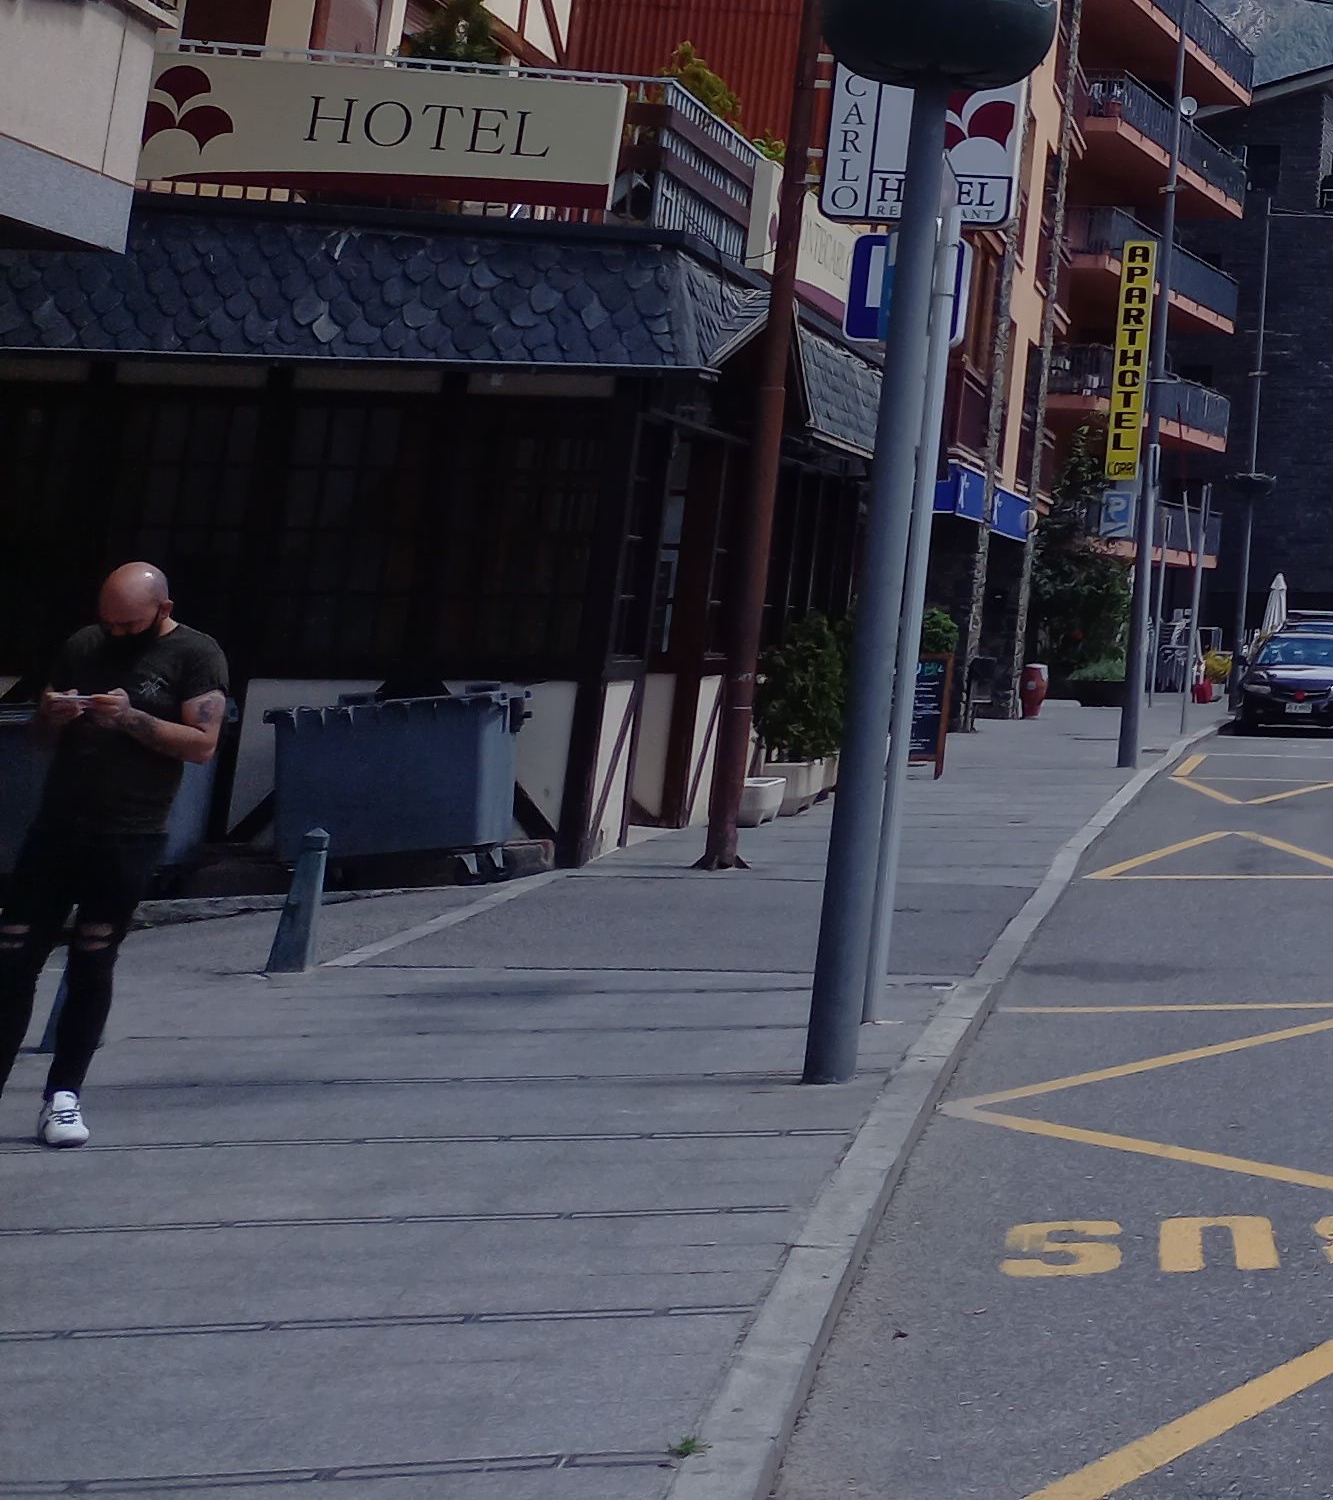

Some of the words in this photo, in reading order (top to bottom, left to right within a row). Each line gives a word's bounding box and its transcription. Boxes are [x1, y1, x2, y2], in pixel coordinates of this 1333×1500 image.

[303, 95, 550, 158] HOTEL
[877, 176, 995, 206] HEL
[1112, 245, 1150, 451] APARTHOTEL
